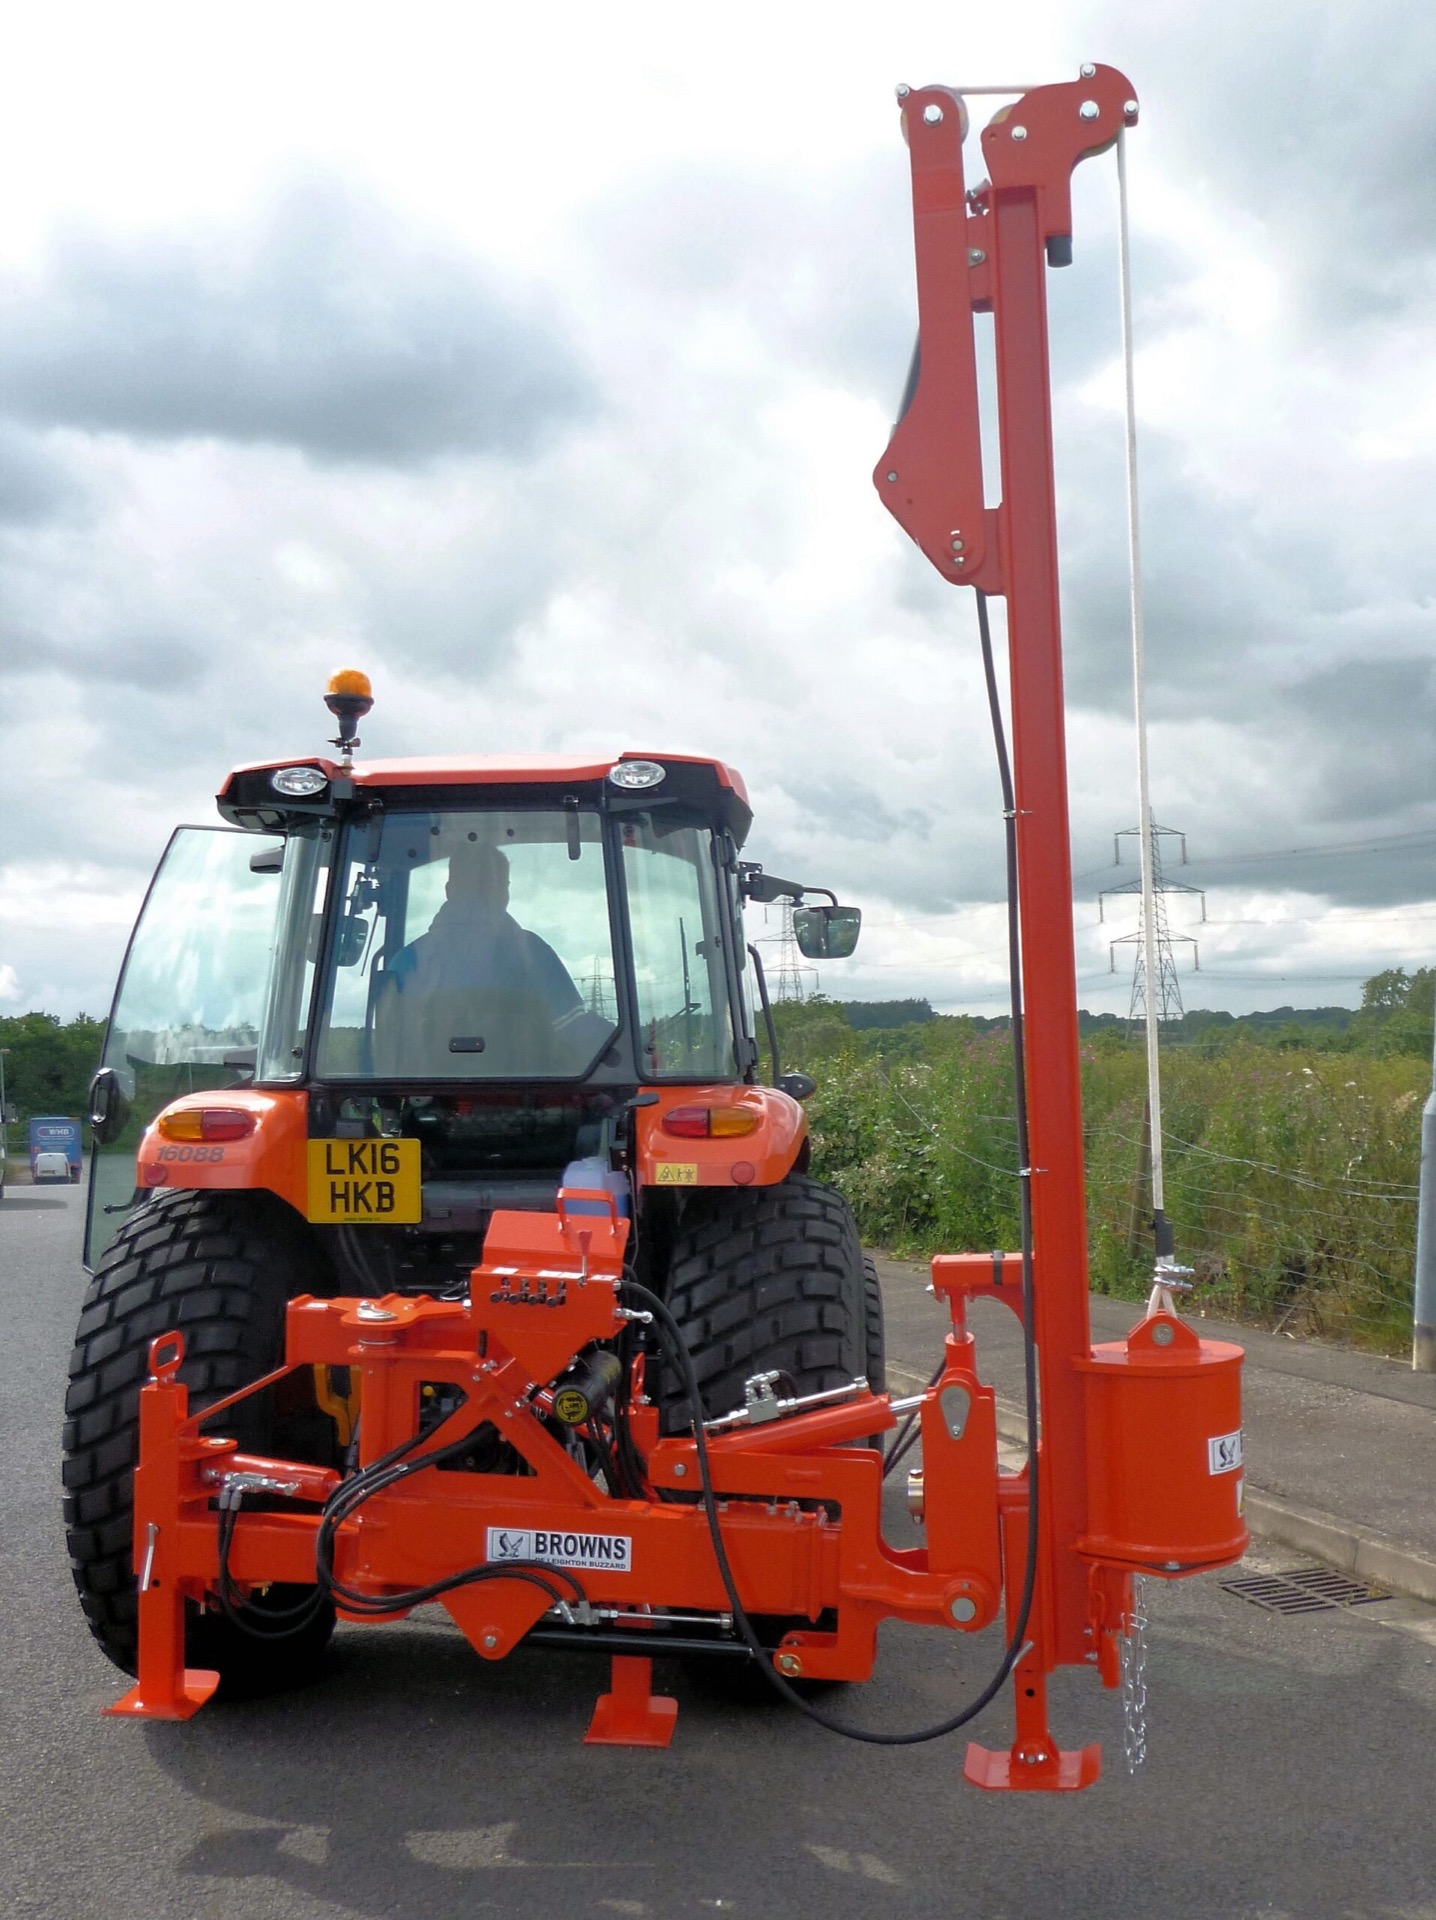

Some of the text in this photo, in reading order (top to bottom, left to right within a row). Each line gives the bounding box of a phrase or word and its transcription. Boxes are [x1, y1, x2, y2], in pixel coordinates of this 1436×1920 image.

[325, 1142, 400, 1175] LK16
[330, 1181, 395, 1213] HKB
[535, 1532, 626, 1560] BROWNS
[547, 1558, 587, 1567] LEIGHTON
[589, 1561, 626, 1569] BUZZARD
